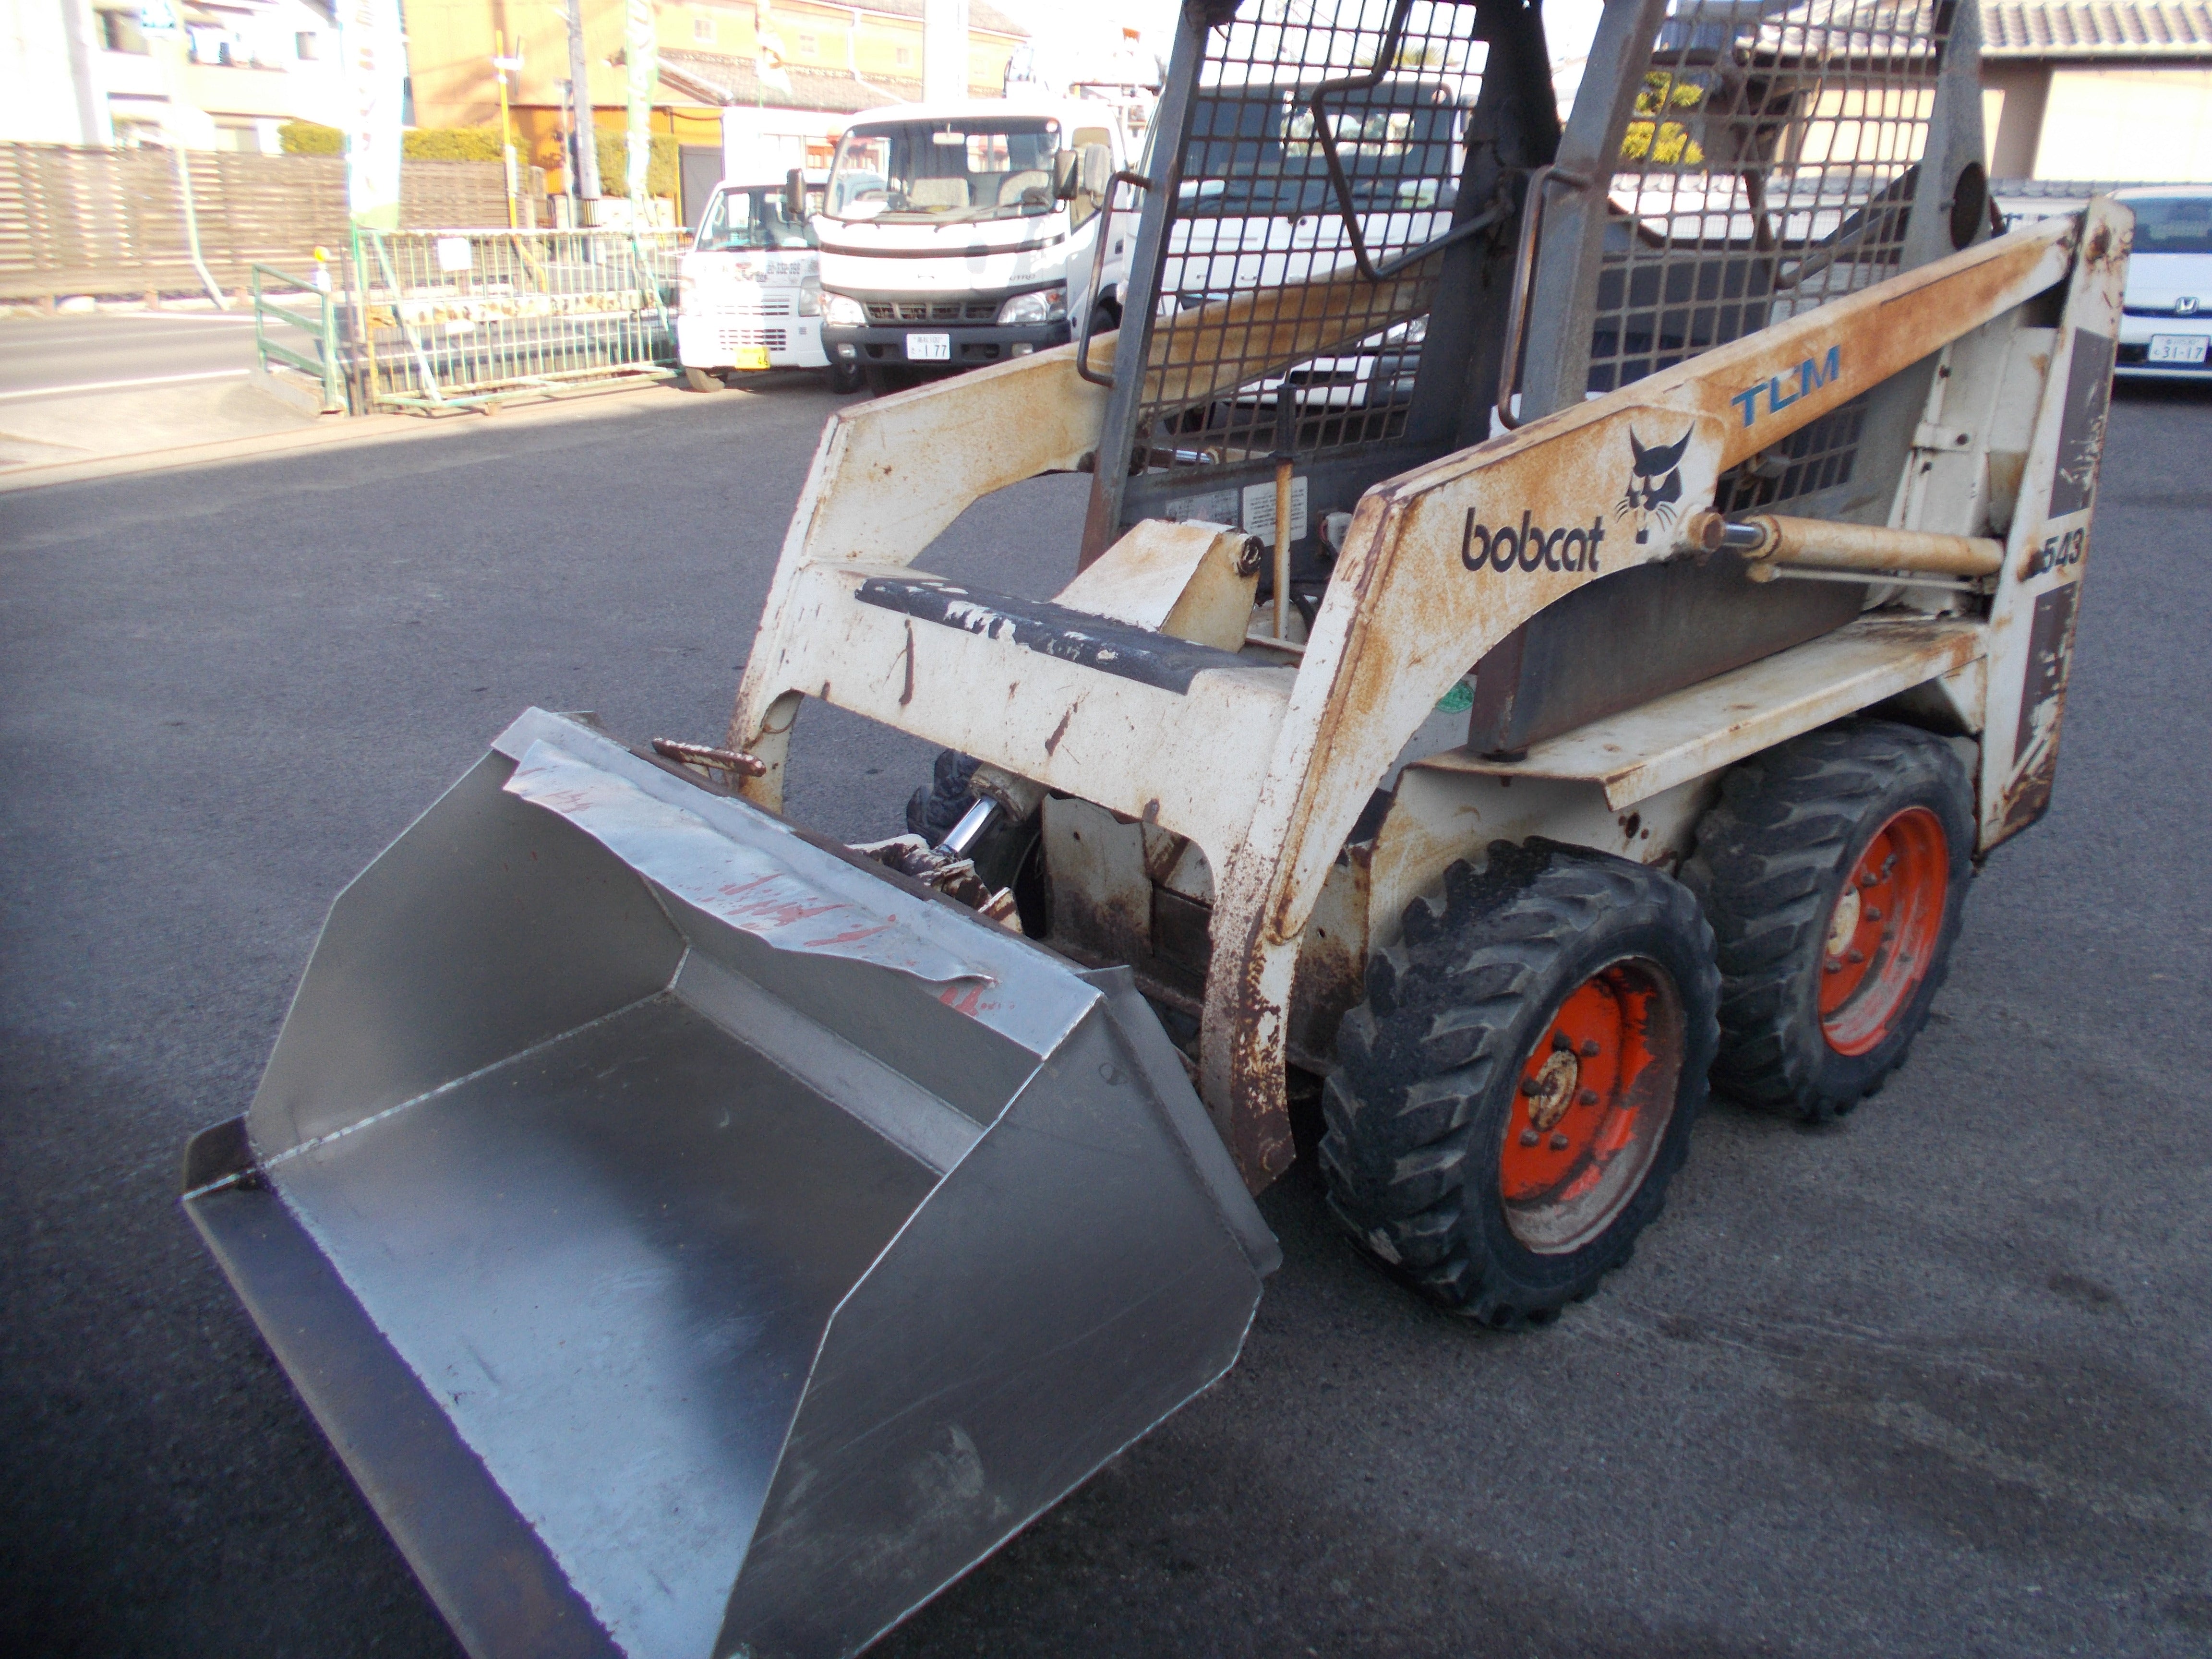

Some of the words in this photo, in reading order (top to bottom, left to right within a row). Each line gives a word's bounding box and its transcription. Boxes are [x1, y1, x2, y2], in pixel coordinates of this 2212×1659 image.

[2163, 346, 2203, 359] 31-17
[1462, 507, 1605, 573] bobcat
[2042, 527, 2084, 574] 543
